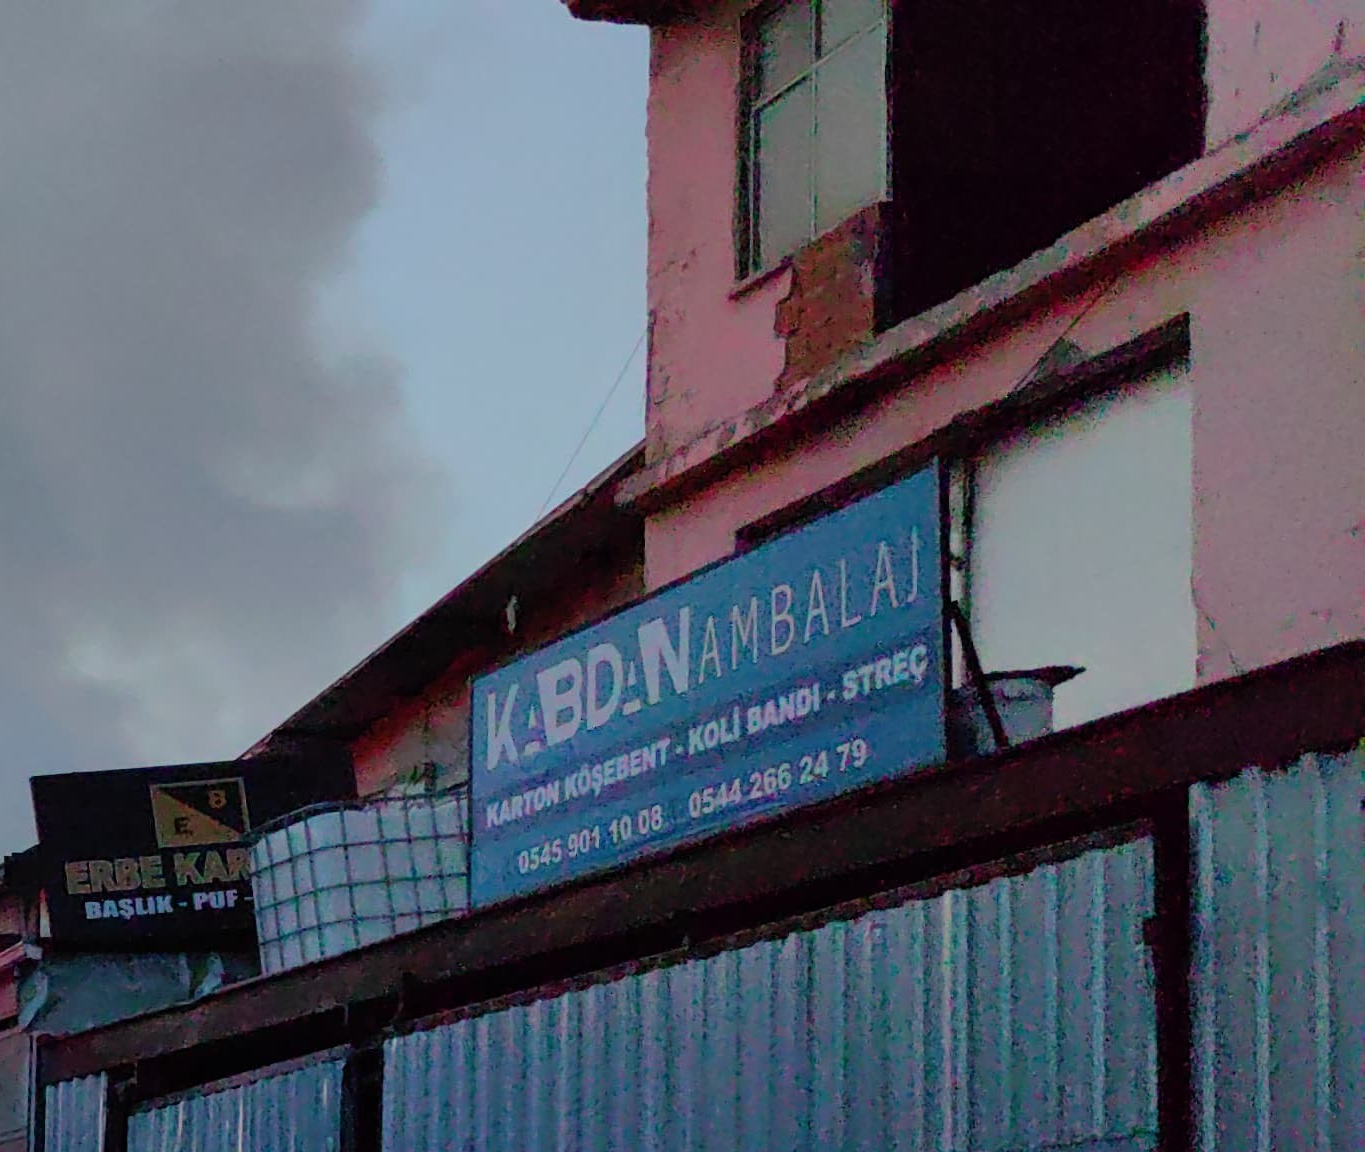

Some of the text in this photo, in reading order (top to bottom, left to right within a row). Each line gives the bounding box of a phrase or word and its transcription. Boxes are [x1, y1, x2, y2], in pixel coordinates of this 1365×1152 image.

[698, 525, 920, 684] AMBALAJ
[486, 644, 929, 828] KARTON KÖŞEBENT KOLİ BANDI STREÇ
[518, 738, 869, 875] 0545 901 10 08 0544 266 24 79
[65, 856, 166, 895] ERBE
[84, 895, 175, 922] BAŞLIK
